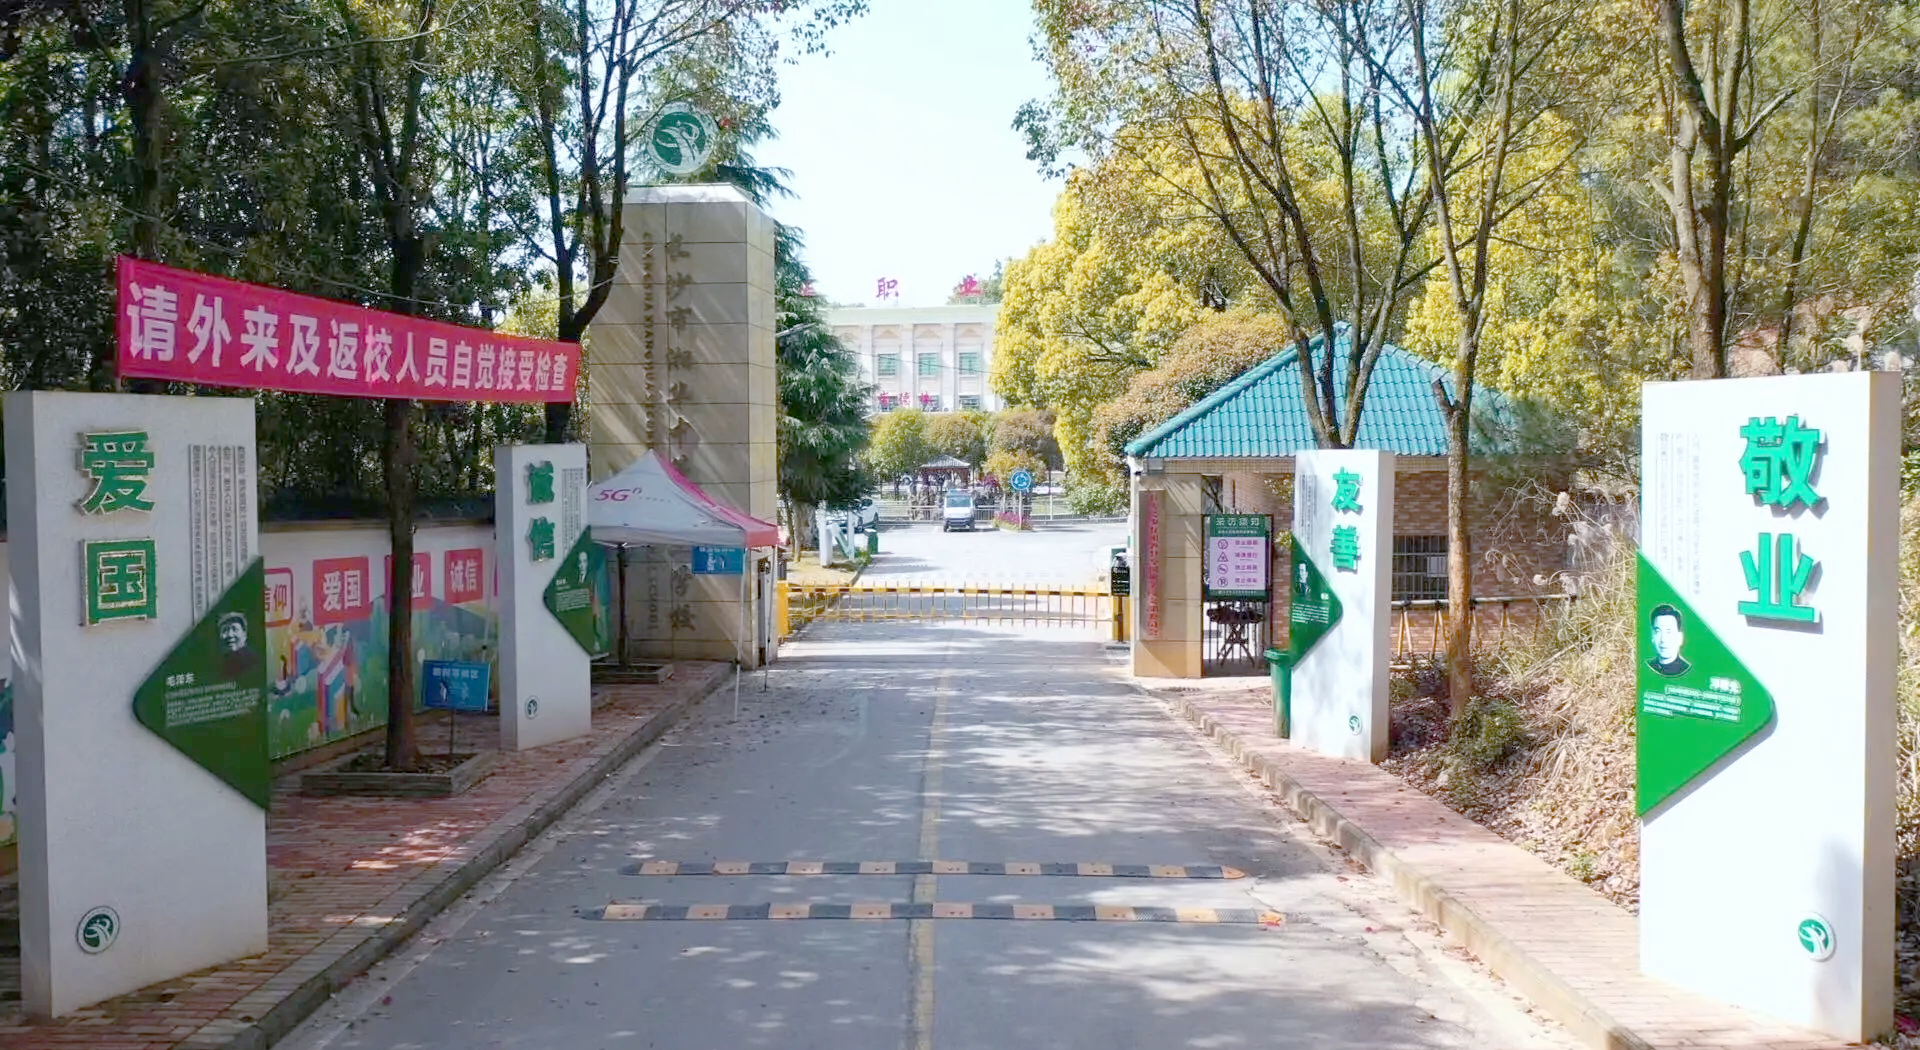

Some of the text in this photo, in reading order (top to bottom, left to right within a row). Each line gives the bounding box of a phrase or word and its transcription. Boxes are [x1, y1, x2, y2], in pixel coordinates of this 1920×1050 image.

[126, 281, 568, 391] 请外来及返校人员自觉接受检查
[78, 431, 157, 626] 爱国
[1330, 467, 1362, 573] 友善
[1738, 415, 1822, 623] 敬业
[322, 569, 362, 612] 爱国
[411, 563, 425, 598] 业
[450, 558, 478, 594] 诚信
